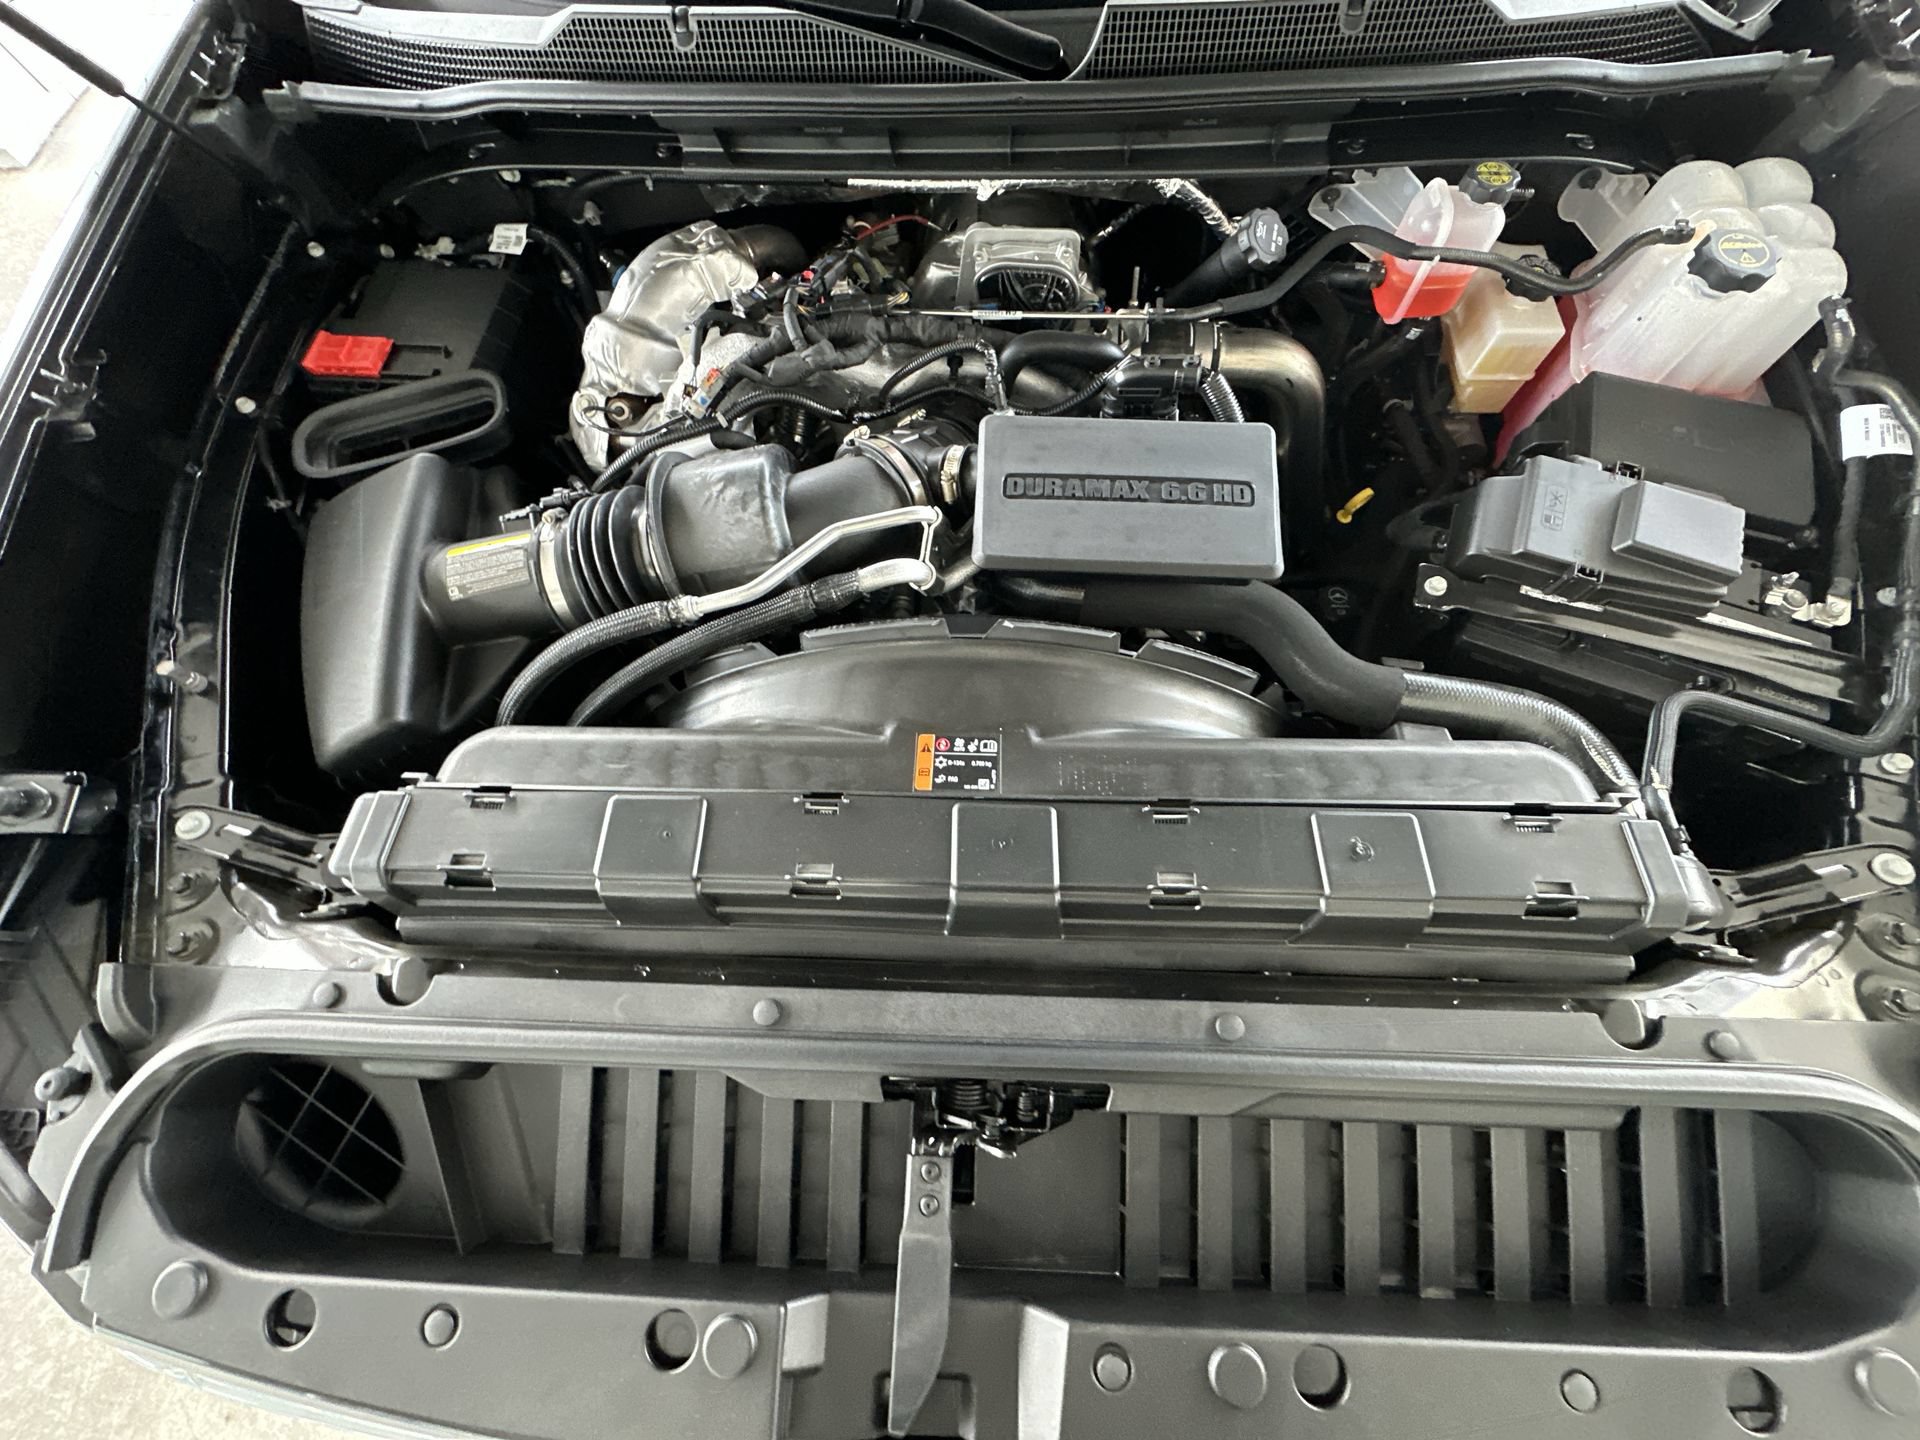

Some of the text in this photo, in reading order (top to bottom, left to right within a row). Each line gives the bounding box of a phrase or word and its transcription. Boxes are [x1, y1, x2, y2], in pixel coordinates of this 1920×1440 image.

[1006, 476, 1253, 504] DURAMAX 6.6 HD
